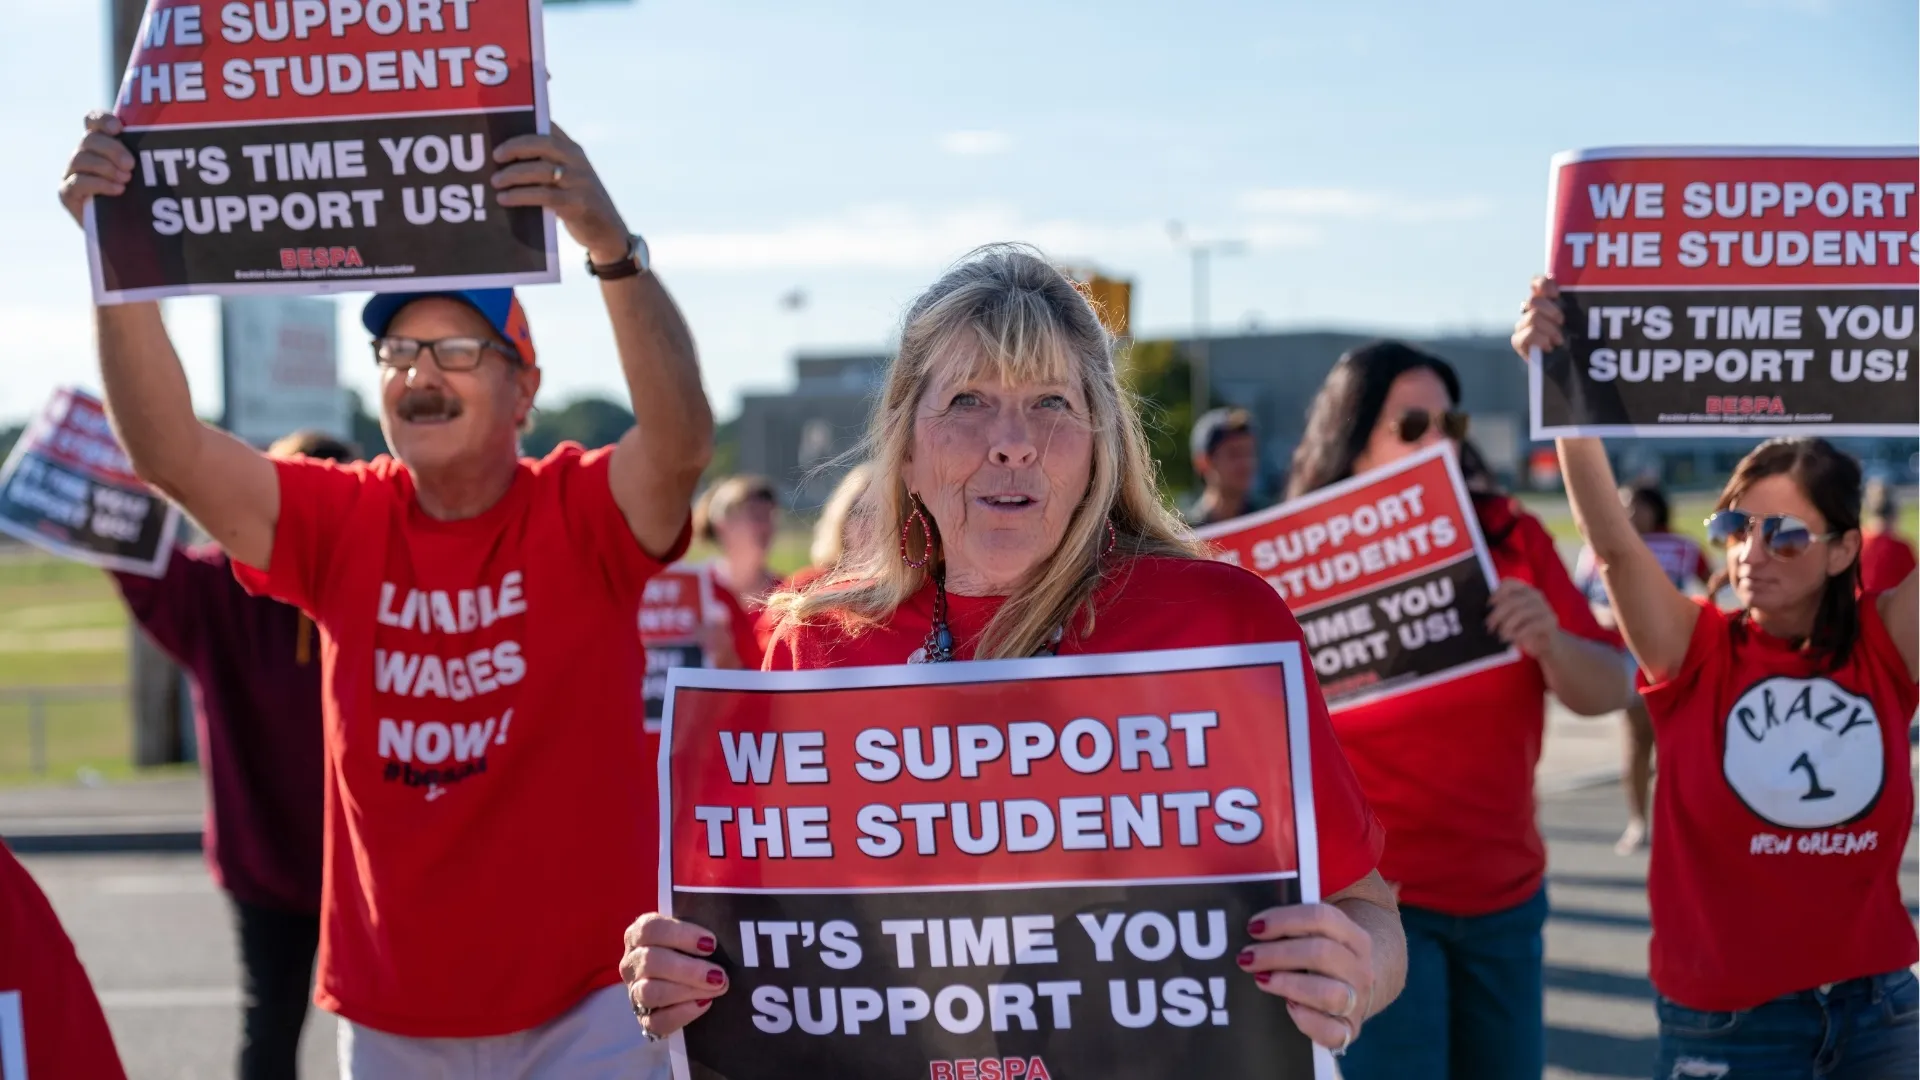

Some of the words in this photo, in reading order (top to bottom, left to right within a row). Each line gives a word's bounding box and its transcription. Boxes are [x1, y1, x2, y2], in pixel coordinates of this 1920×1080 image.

[142, 5, 204, 50] WE
[220, 0, 478, 43] SUPPORT
[122, 61, 208, 106] THE
[222, 43, 510, 101] STUDENTS
[139, 146, 231, 188] IT’S
[242, 139, 368, 183] TIME
[379, 133, 487, 176] YOU
[151, 188, 385, 237] SUPPORT
[402, 184, 487, 226] US!
[1588, 182, 1665, 219] WE
[1683, 180, 1916, 219] SUPPORT
[280, 246, 364, 269] BESPA
[1564, 231, 1662, 269] THE
[1588, 306, 1674, 340] IT’S
[1687, 305, 1802, 340] TIME
[1817, 304, 1914, 340] YOU
[1588, 349, 1814, 383] SUPPORT
[1830, 348, 1909, 383] US!
[1705, 395, 1785, 415] BESPA
[1252, 483, 1425, 571] SUPPORT
[1377, 576, 1457, 623] YOU
[1398, 608, 1463, 651] US!
[374, 639, 527, 702] WAGES
[377, 707, 514, 765] NOW!
[1736, 685, 1874, 744] CRAZY
[719, 730, 830, 786] WE
[854, 710, 1219, 783] SUPPORT
[1789, 751, 1836, 802] 1
[695, 804, 834, 859] THE
[855, 785, 1264, 858] STUDENTS
[1750, 833, 1794, 856] NEW
[1796, 831, 1879, 857] ORLEANS
[739, 918, 863, 970] IT’S
[881, 914, 1059, 969] TIME
[1076, 908, 1228, 963] YOU
[751, 980, 1082, 1036] SUPPORT
[1108, 976, 1229, 1028] US!
[929, 1056, 1051, 1080] BESPA
